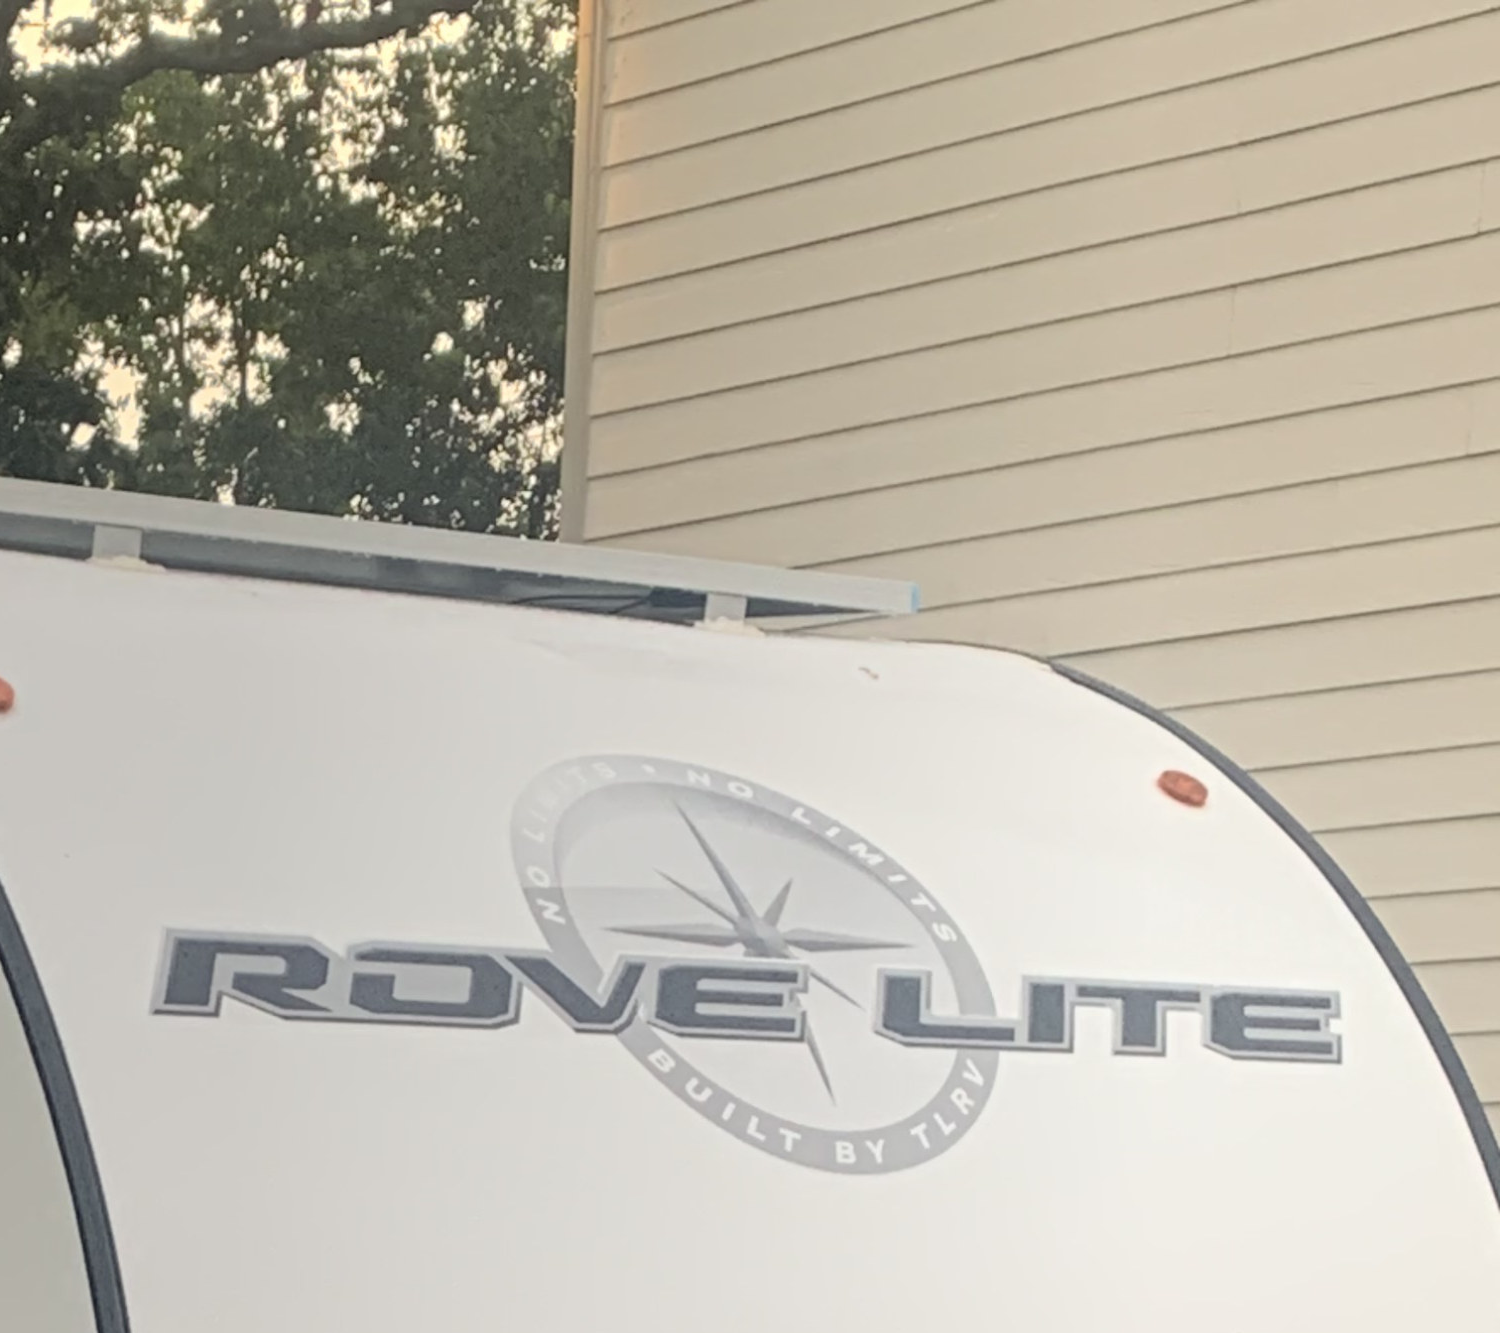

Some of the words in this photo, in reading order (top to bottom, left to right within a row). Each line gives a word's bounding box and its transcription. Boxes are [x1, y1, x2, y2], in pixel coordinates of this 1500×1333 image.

[522, 760, 619, 843] LIMITS
[685, 767, 755, 800] NO
[789, 805, 958, 944] LIMITS
[528, 866, 567, 926] NO
[151, 926, 809, 1043] ROVE
[874, 967, 1343, 1065] LITE
[647, 1047, 802, 1154] BUILT
[834, 1138, 886, 1165] BY
[910, 1058, 986, 1150] TLRV
